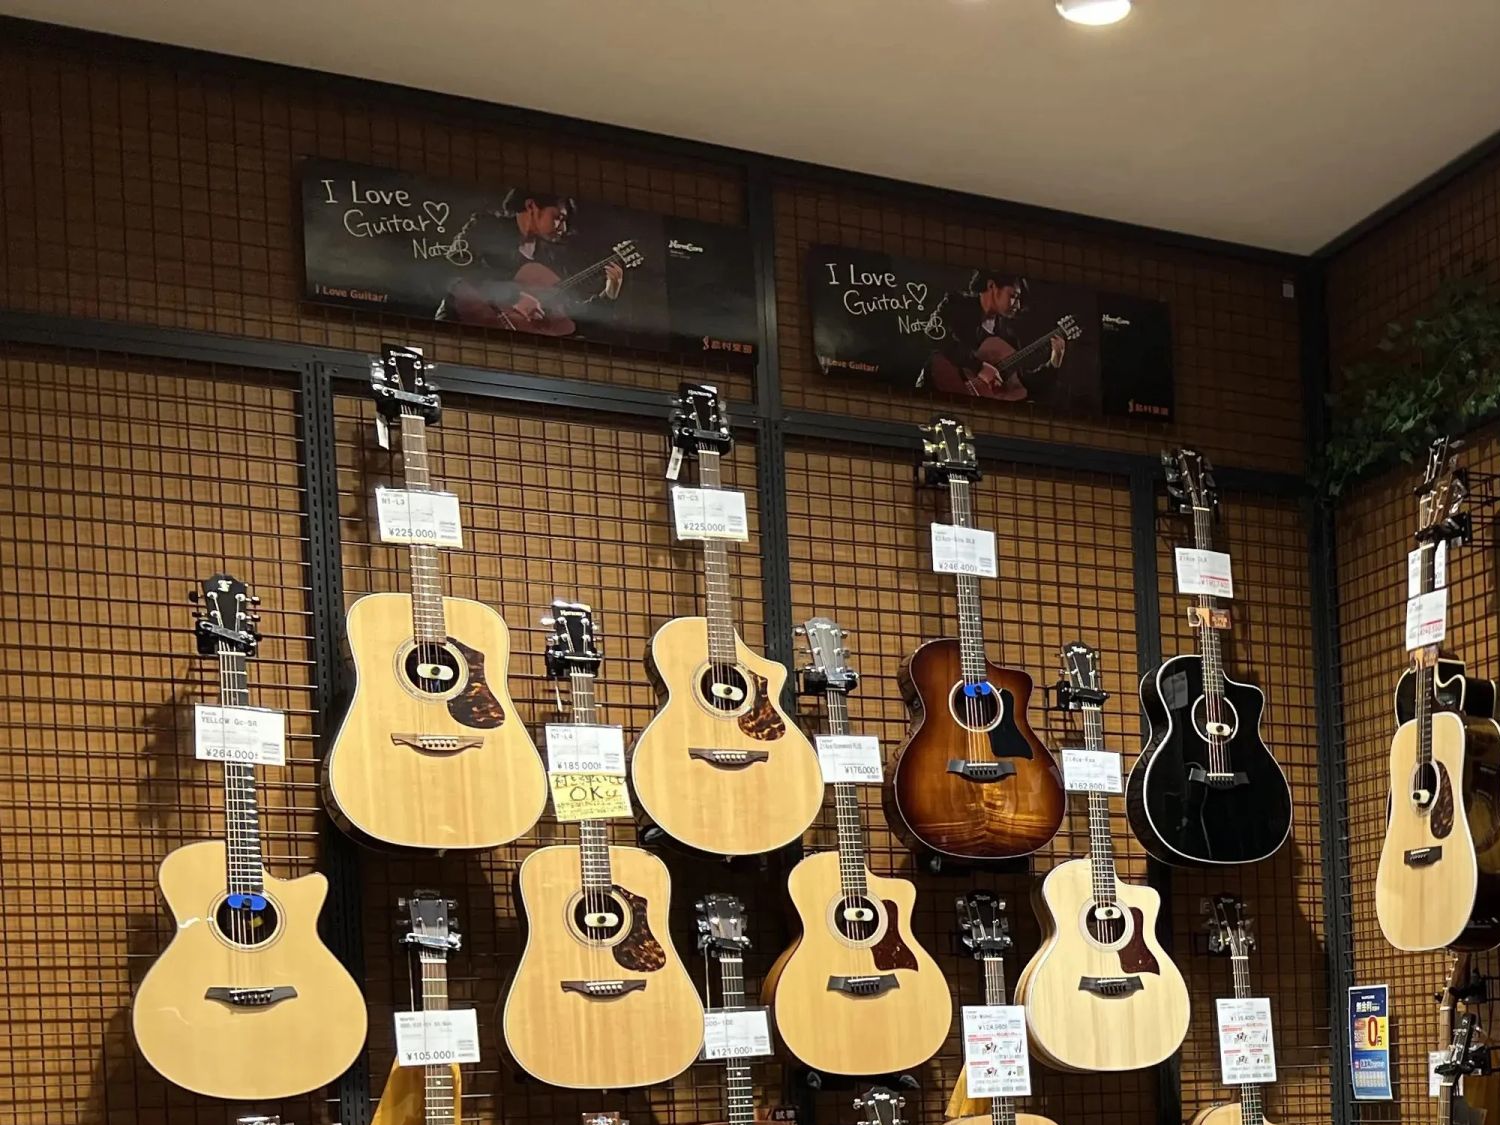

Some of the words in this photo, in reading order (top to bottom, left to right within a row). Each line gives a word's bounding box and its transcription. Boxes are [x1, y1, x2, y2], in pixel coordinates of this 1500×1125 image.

[321, 180, 338, 204] I
[351, 180, 411, 206] Love
[826, 263, 839, 284] I
[849, 263, 896, 287] Love
